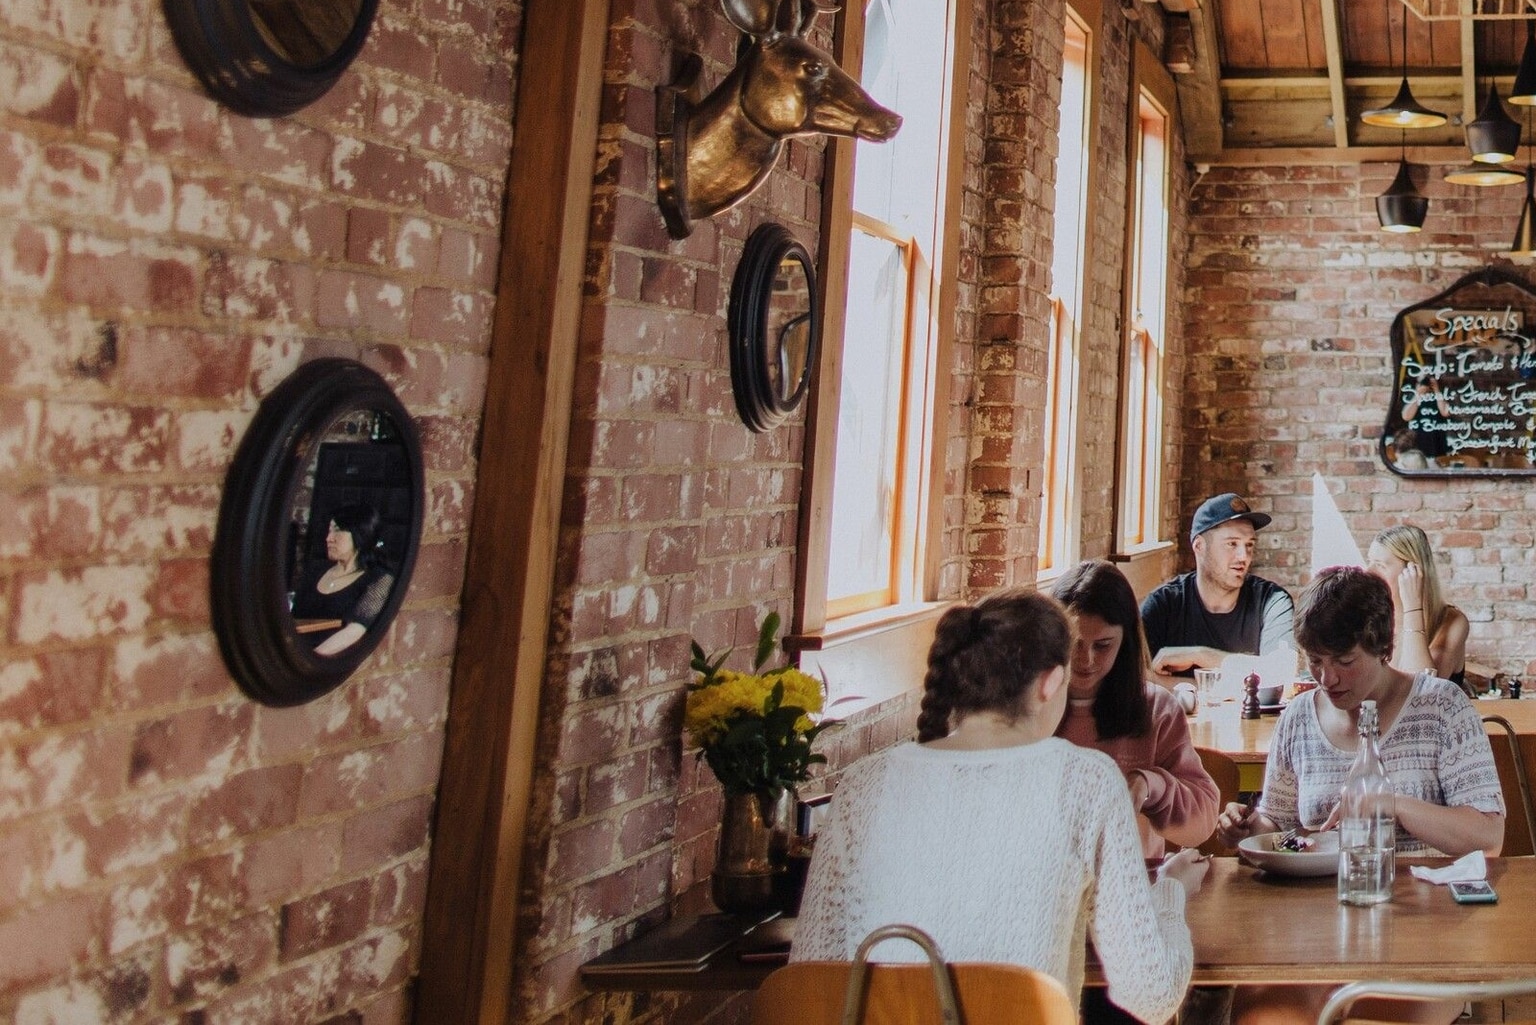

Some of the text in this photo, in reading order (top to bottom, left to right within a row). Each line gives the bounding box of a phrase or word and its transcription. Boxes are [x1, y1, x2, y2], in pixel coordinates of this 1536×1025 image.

[1430, 305, 1519, 339] Specials
[1456, 349, 1504, 375] Tomato
[1457, 380, 1507, 403] French
[1421, 407, 1438, 416] on
[1420, 419, 1472, 439] Blueberry
